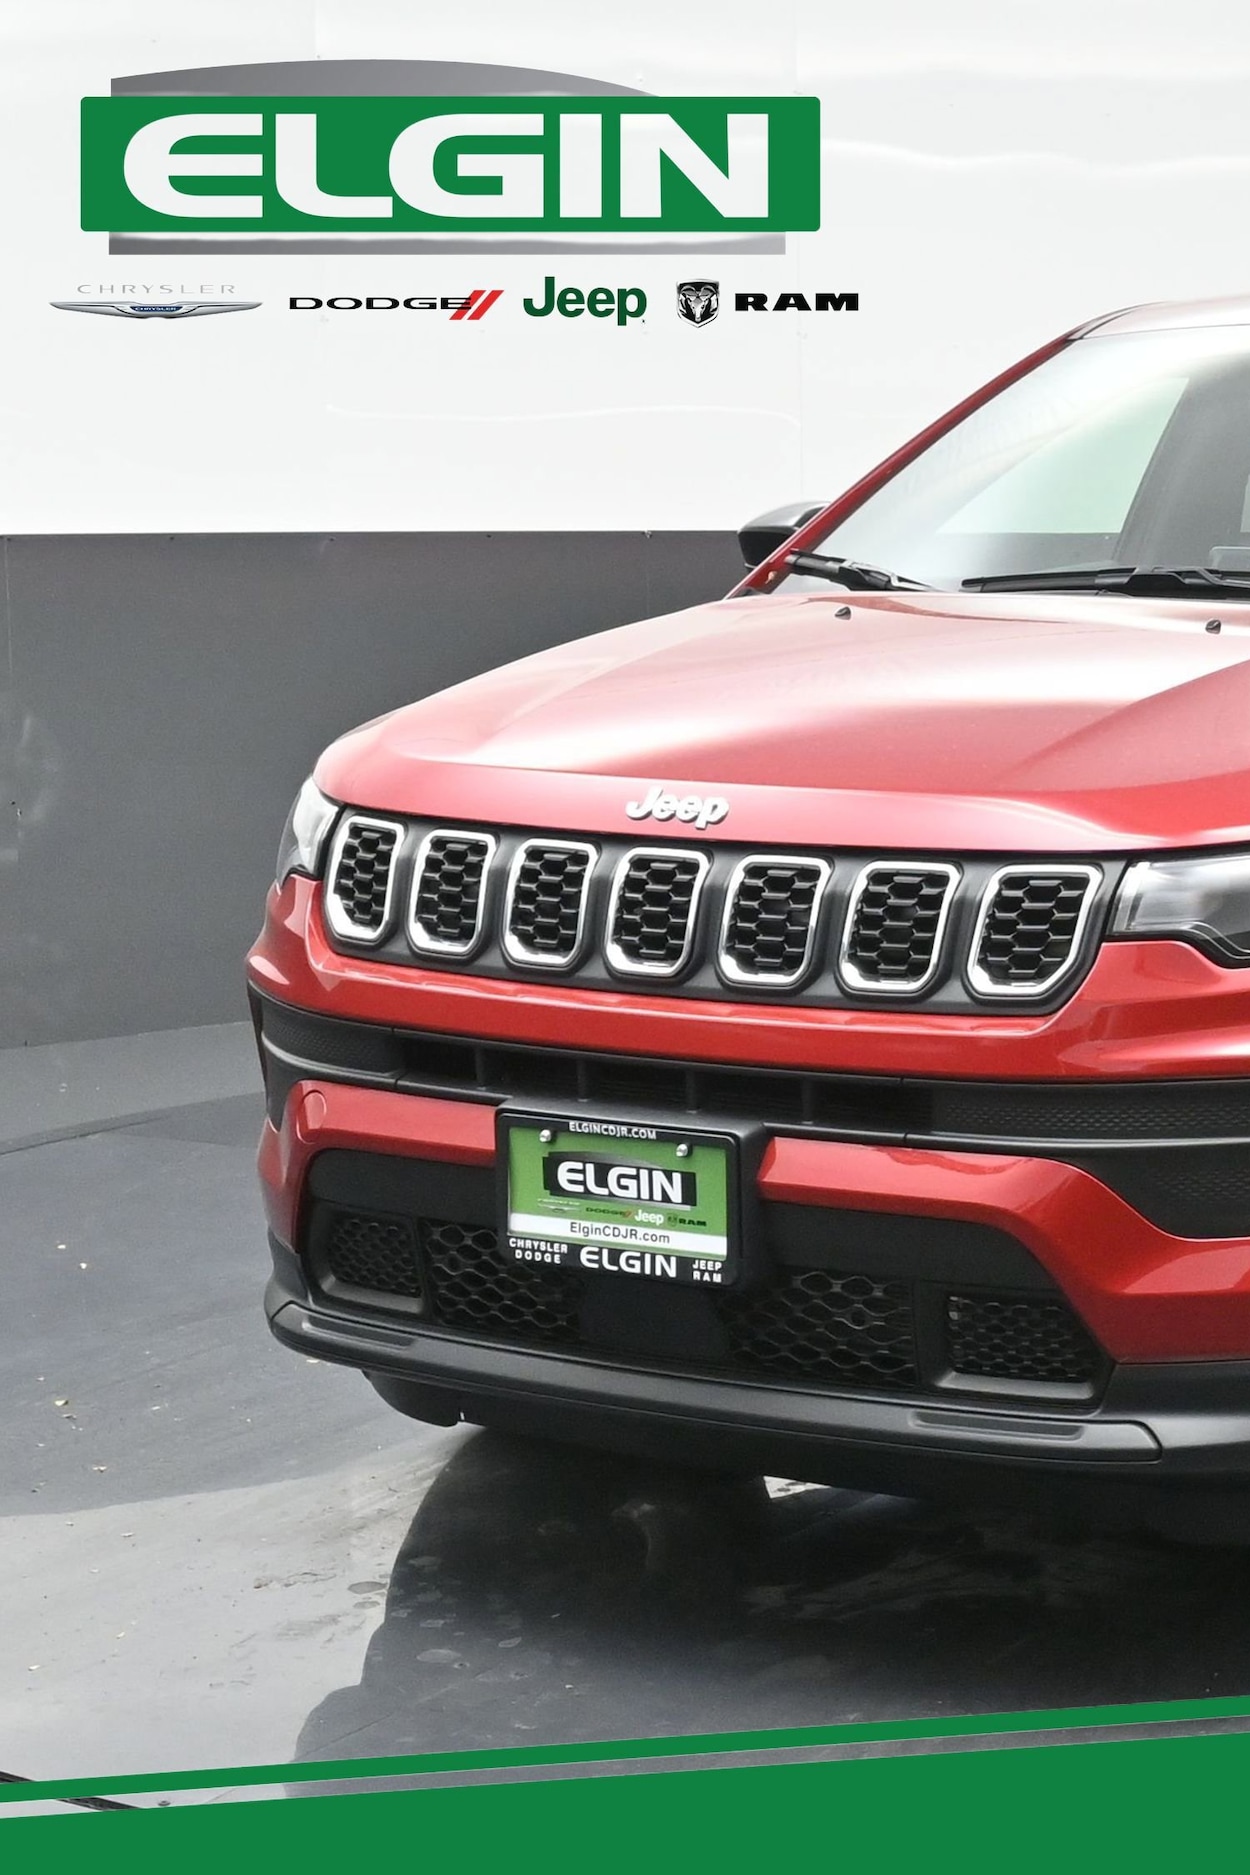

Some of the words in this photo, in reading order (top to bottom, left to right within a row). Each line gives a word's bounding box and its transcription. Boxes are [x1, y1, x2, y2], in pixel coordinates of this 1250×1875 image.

[625, 785, 730, 831] Jeep
[568, 1121, 657, 1140] ELGINCDJR.COM
[556, 1160, 683, 1204] ELGIN
[634, 1209, 665, 1226] Jeep
[678, 1218, 707, 1227] RAM
[570, 1221, 671, 1245] ElginCDJR.com
[508, 1237, 568, 1255] CHRYSLER
[514, 1248, 562, 1265] DODGE
[579, 1246, 677, 1278] ELGIN
[692, 1259, 722, 1271] JEEP
[692, 1271, 723, 1284] RAM
